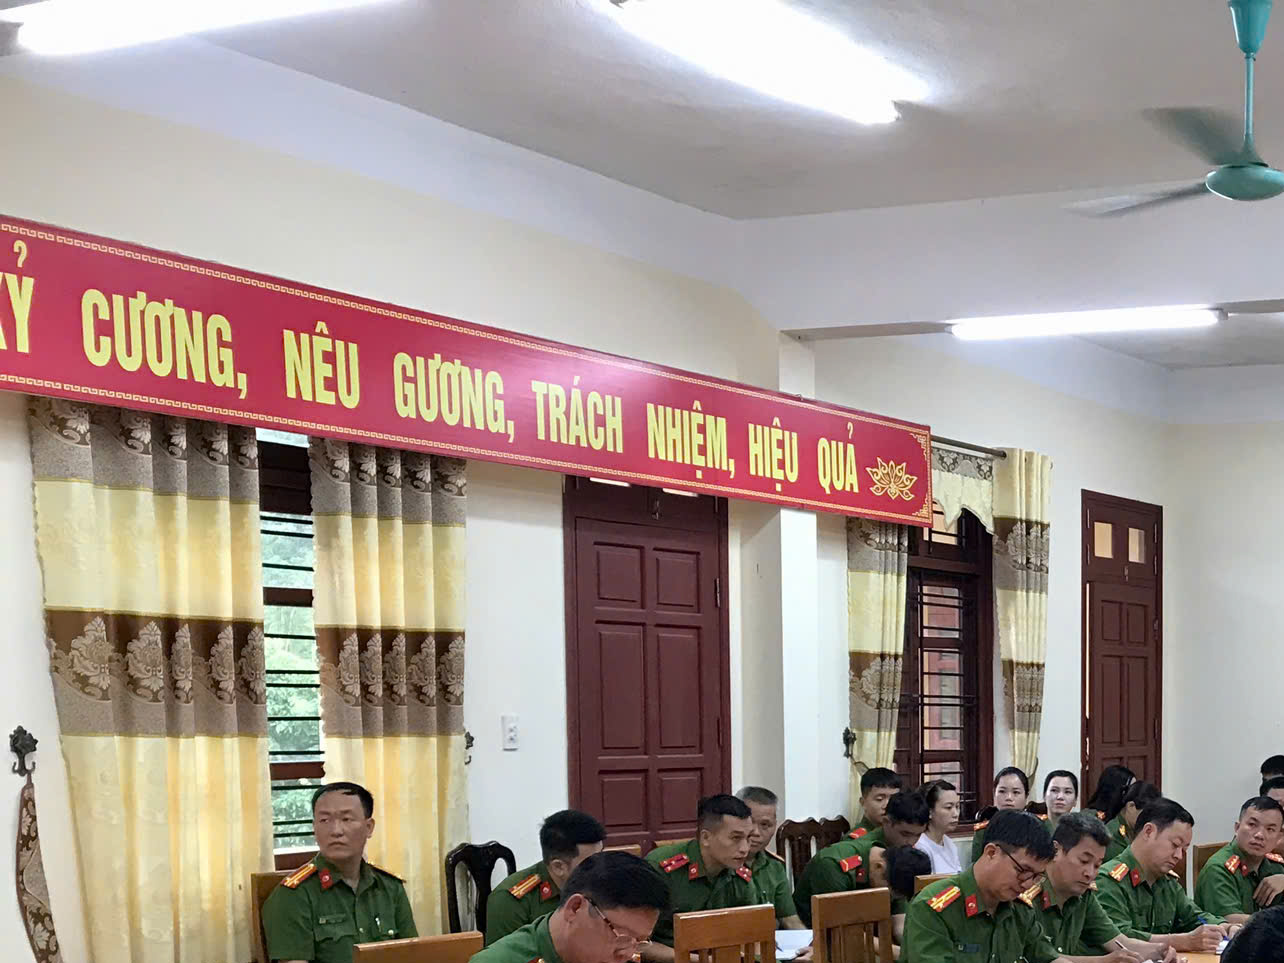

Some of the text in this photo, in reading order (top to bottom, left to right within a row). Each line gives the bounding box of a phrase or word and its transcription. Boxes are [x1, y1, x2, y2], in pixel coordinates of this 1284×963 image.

[81, 289, 248, 399] CƯƠNG,
[283, 321, 360, 409] NÊU
[393, 352, 514, 443] GƯƠNG,
[531, 376, 624, 453] TRÁCH
[647, 401, 735, 479] NHIỆM,
[748, 417, 799, 491] HIỆU
[817, 422, 859, 495] QUẢ
